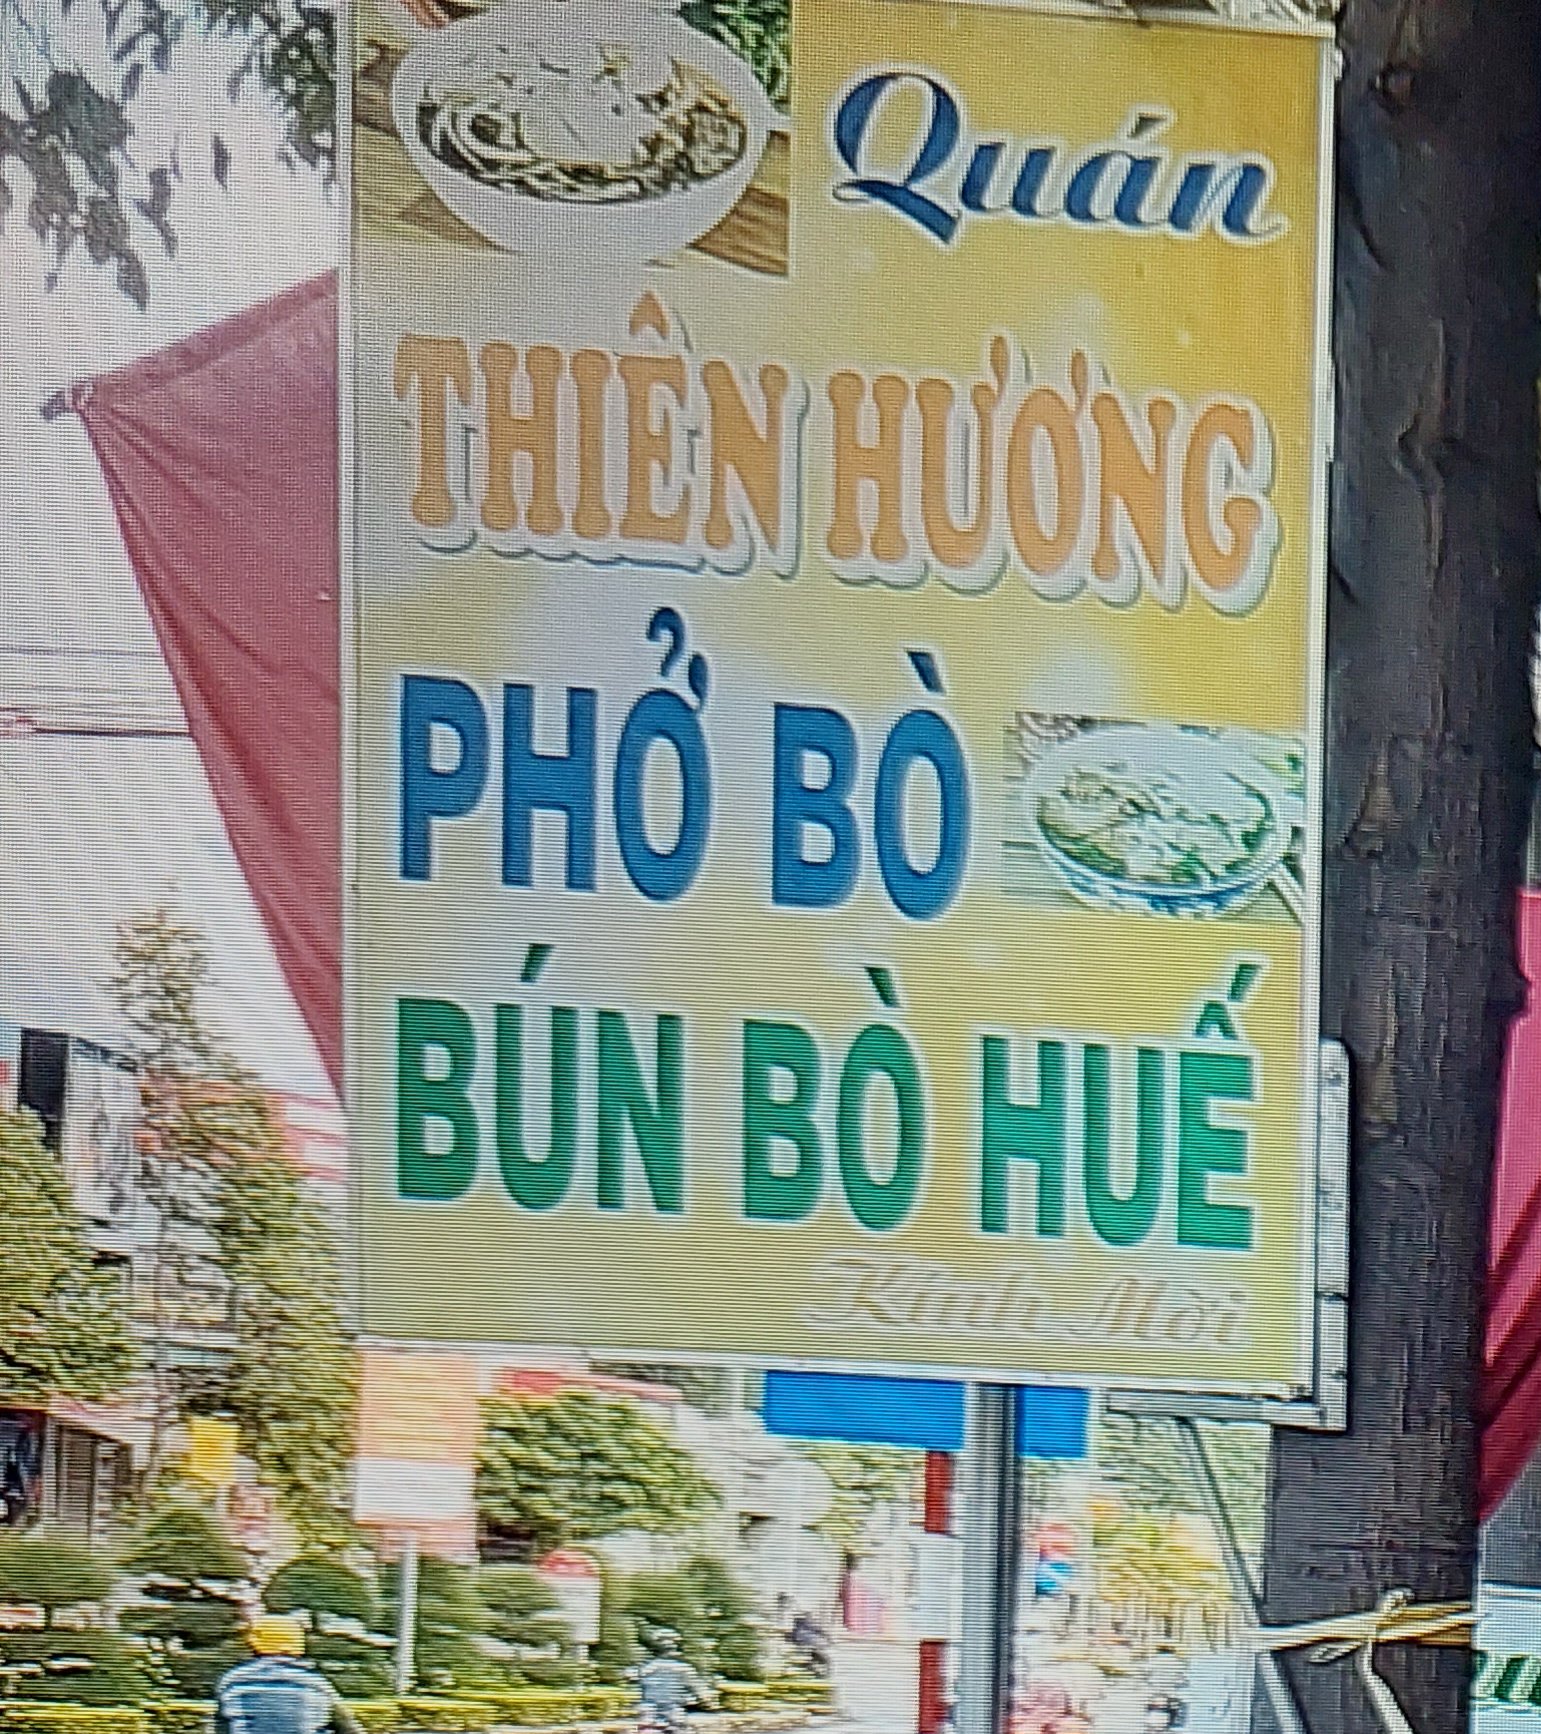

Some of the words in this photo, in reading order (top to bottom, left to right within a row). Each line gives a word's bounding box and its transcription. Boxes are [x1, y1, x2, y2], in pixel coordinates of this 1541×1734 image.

[831, 70, 1283, 246] Quán
[397, 290, 800, 568] THIÊN
[822, 335, 1272, 602] HƯƠNG
[399, 606, 712, 904] PHỞ
[770, 648, 971, 922] BÒ
[396, 942, 686, 1213] BÚN
[740, 964, 926, 1232] BÒ
[979, 963, 1259, 1252] HUẾ
